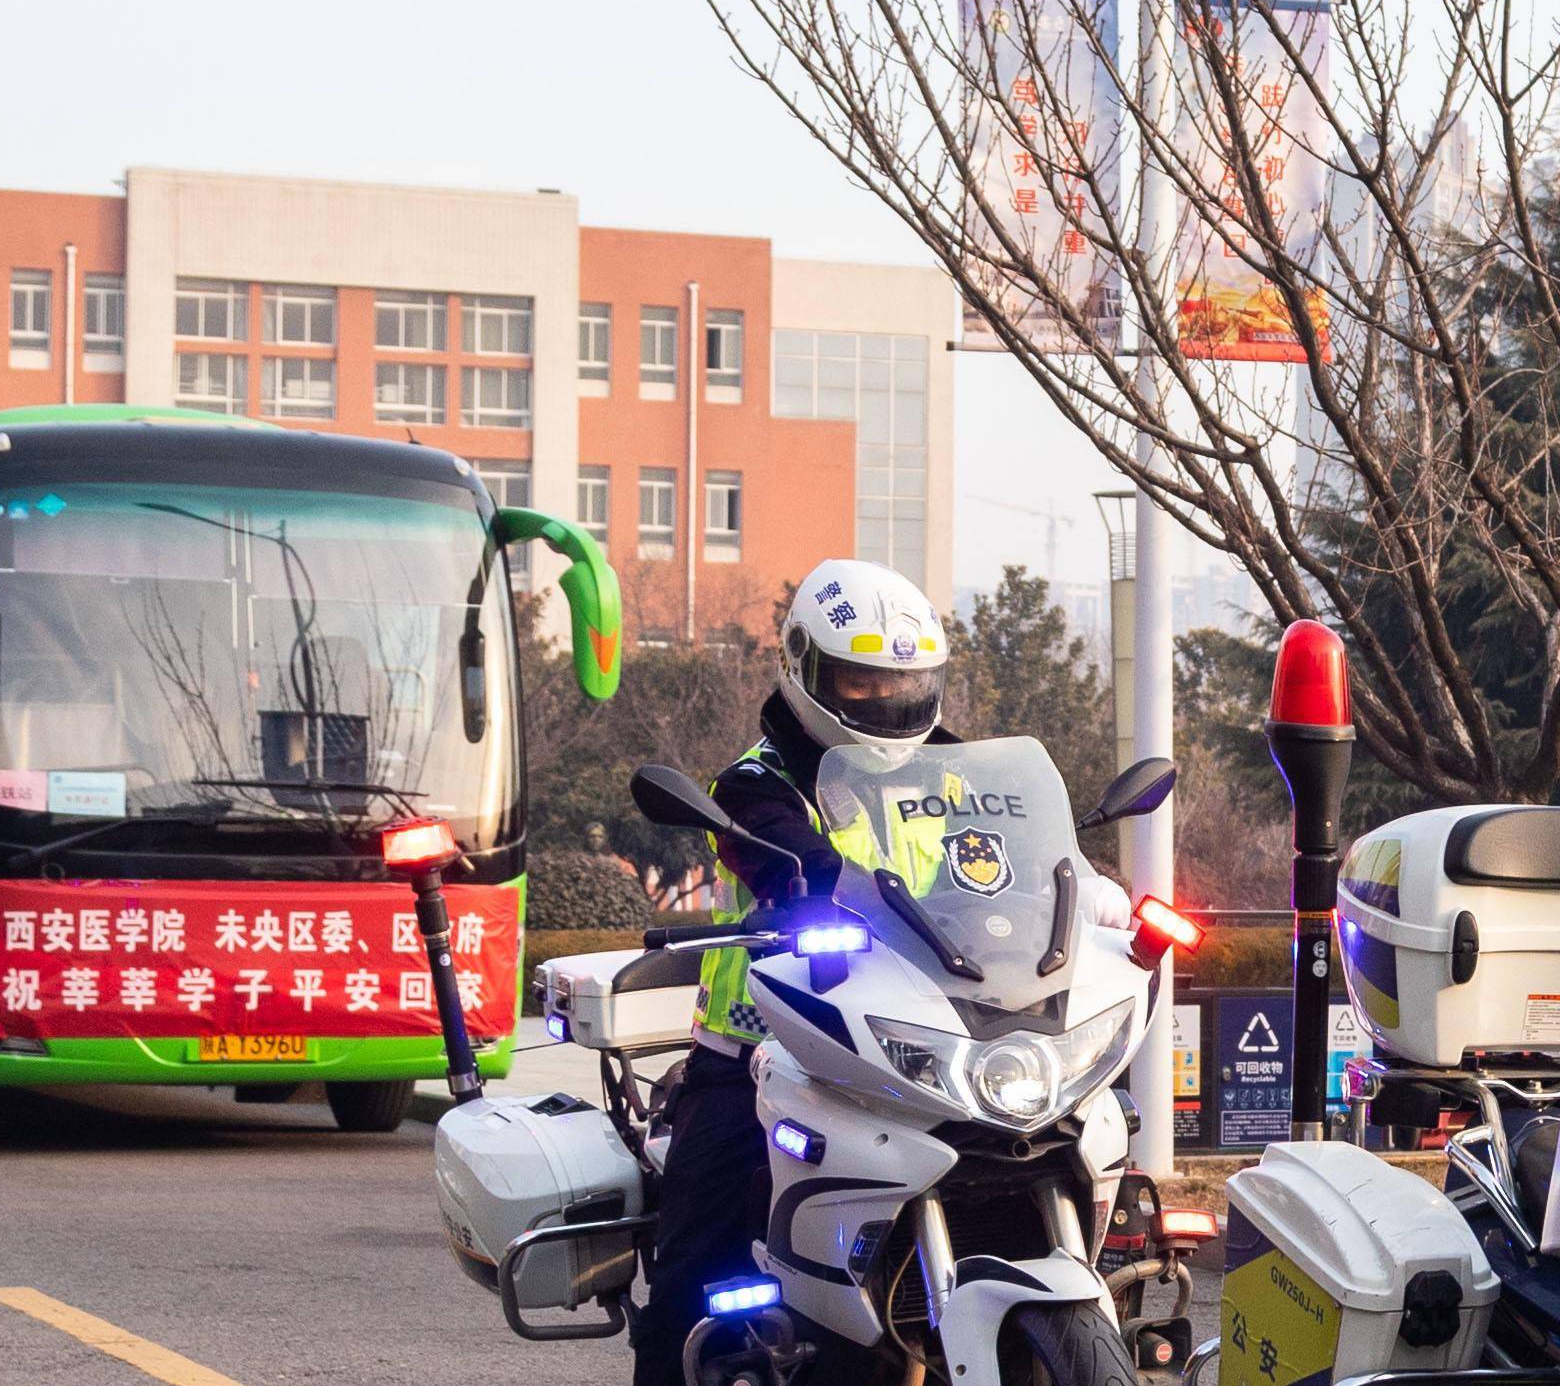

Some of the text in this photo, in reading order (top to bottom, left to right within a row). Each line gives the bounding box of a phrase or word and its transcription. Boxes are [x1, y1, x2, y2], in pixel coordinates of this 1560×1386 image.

[814, 580, 858, 630] 警察
[897, 793, 1027, 822] POLICE
[3, 909, 186, 954] 西安医学院
[1235, 1061, 1283, 1075] 可回收物
[1271, 1265, 1325, 1326] GW250J-H
[1232, 1311, 1278, 1383] 公安
